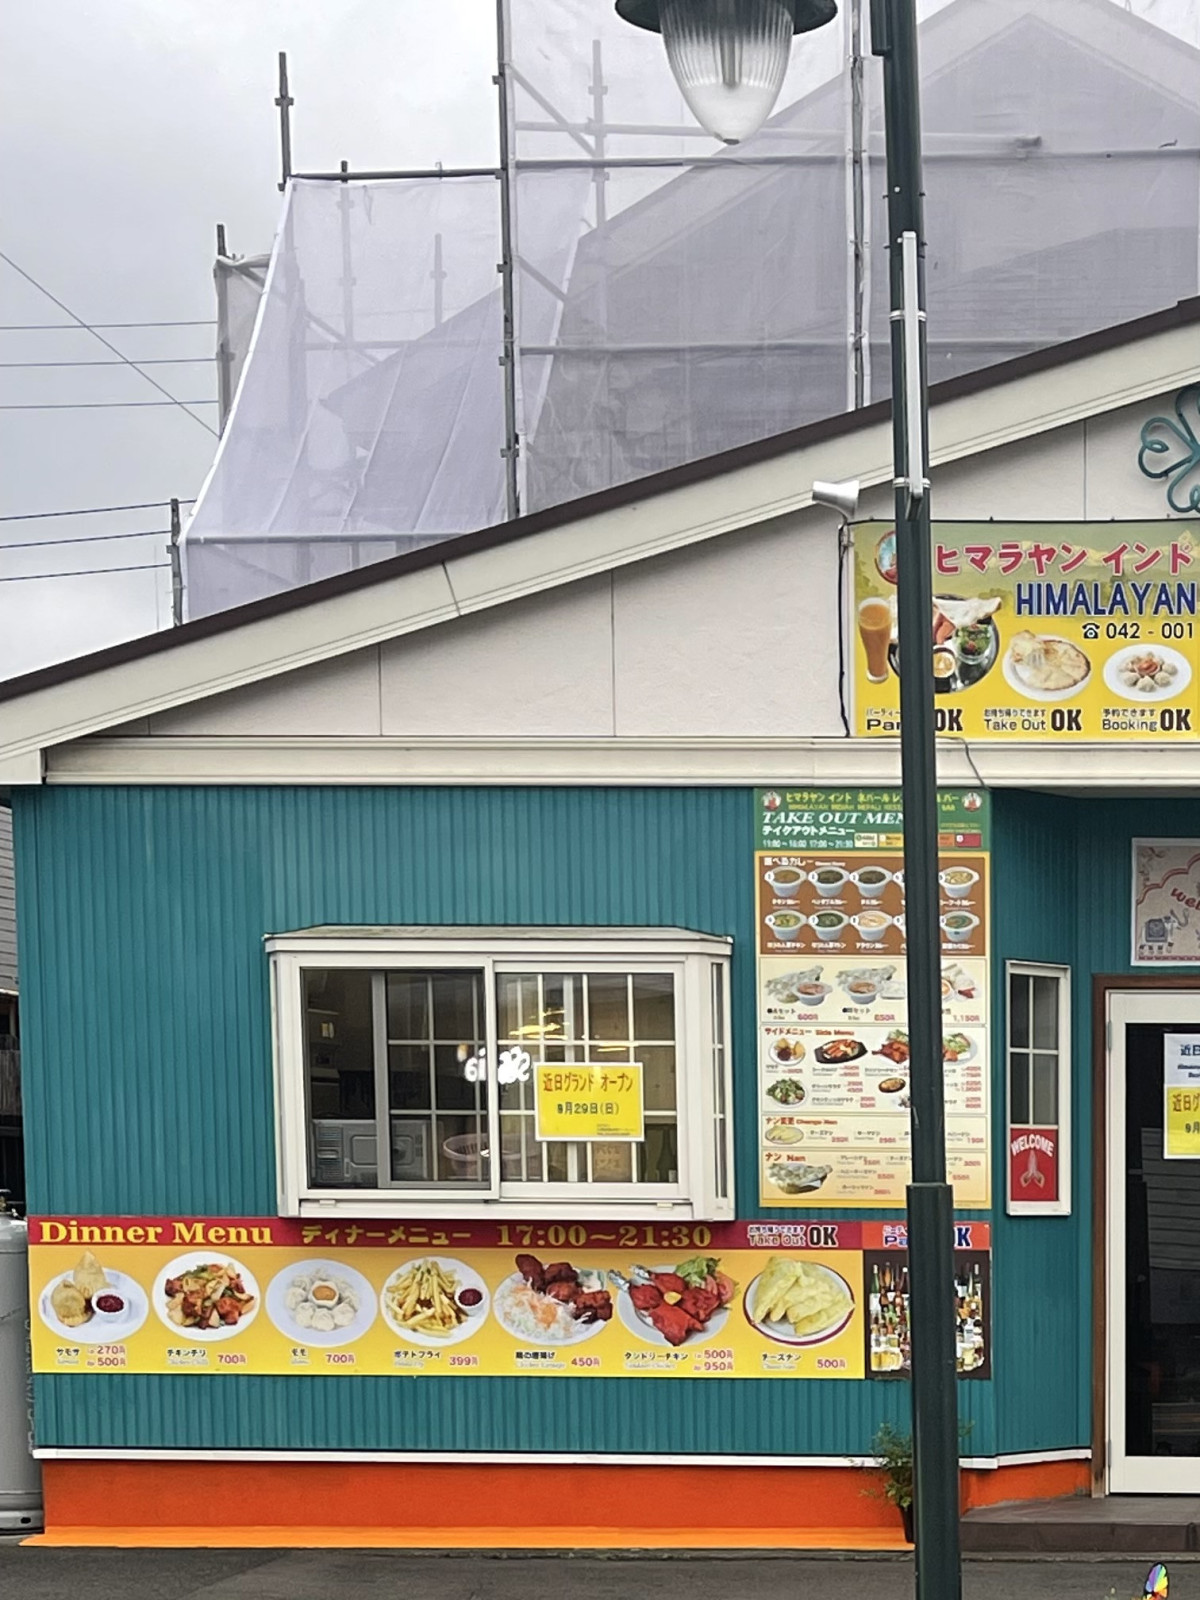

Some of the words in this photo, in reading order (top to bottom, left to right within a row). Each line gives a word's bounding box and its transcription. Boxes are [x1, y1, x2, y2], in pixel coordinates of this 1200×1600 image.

[935, 544, 1088, 576] ヒマラヤン
[1102, 542, 1192, 575] インド
[1016, 582, 1196, 617] HIMALAYAN
[1105, 623, 1141, 639] 042
[1161, 622, 1194, 639] 001
[984, 719, 1017, 731] Take
[1021, 719, 1046, 731] Out
[1050, 708, 1082, 732] OK
[1102, 708, 1155, 718] 予約できます
[1102, 718, 1158, 733] Booking
[1159, 708, 1192, 731] OK
[866, 719, 902, 731] Par
[762, 811, 815, 825] TAKE
[818, 811, 862, 825] OUT
[862, 811, 904, 825] MEN
[762, 825, 856, 836] テイクアウトメニュー
[543, 1072, 594, 1093] 近日グランド
[600, 1072, 633, 1093] オープン
[1010, 1133, 1055, 1158] WELCOME
[765, 1152, 782, 1162] ナン
[39, 1220, 164, 1244] Dinner
[172, 1222, 273, 1244] Menu
[301, 1224, 472, 1245] ディナーメニュー
[748, 1234, 781, 1246] Take
[783, 1234, 806, 1246] Out
[809, 1225, 839, 1246] OK
[56, 1347, 81, 1356] サモサ
[217, 1353, 247, 1364] 700円
[325, 1354, 355, 1364] 700円
